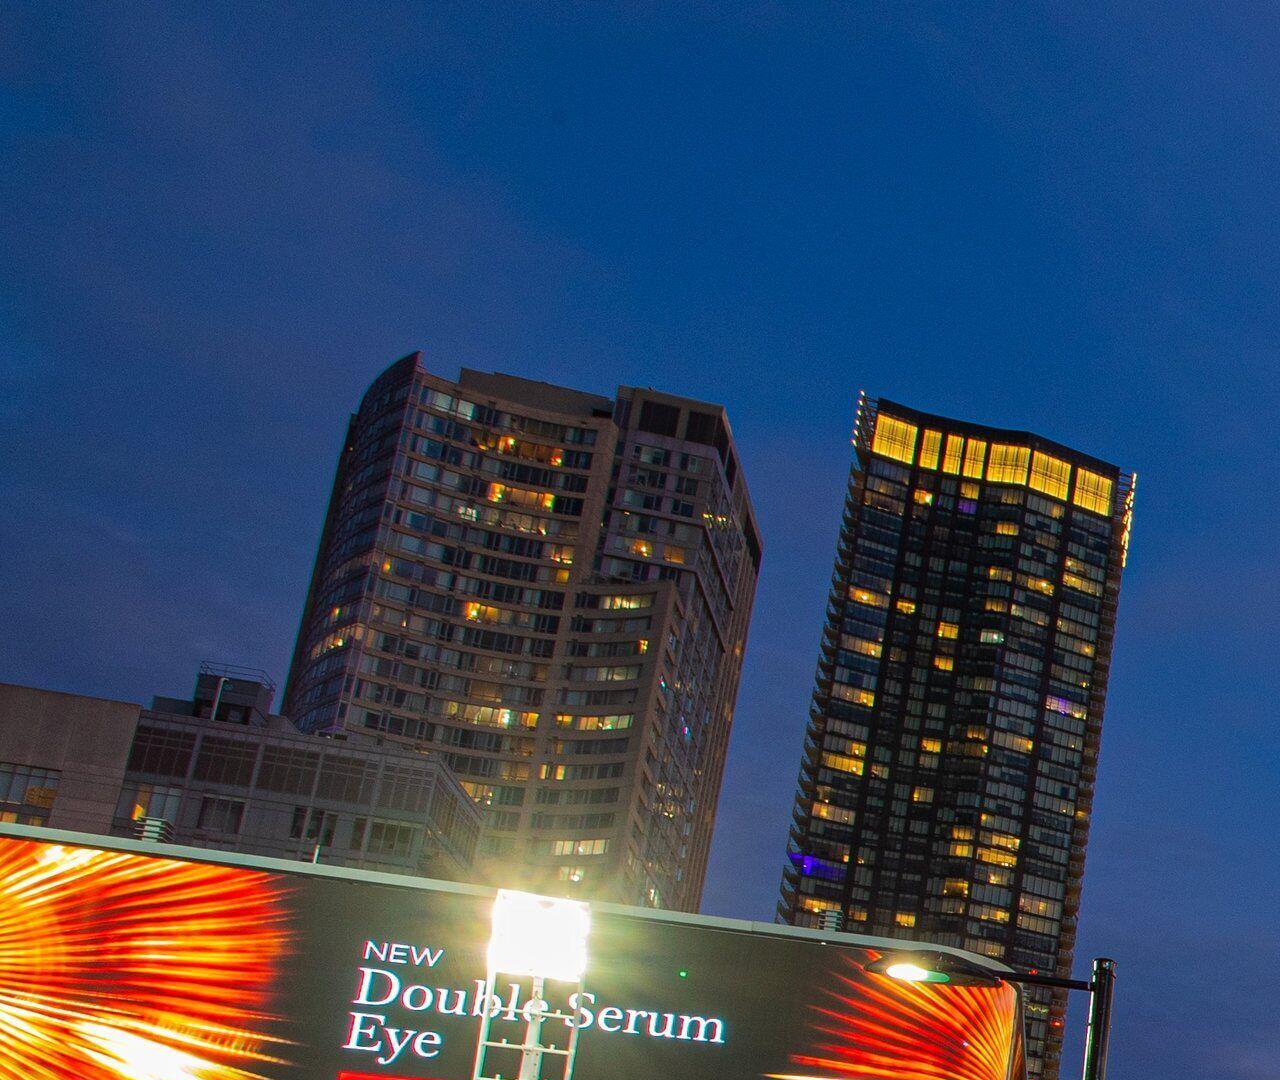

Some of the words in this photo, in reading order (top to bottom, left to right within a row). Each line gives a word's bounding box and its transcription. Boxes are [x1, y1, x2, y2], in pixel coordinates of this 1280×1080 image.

[362, 940, 444, 967] NEW
[352, 966, 548, 1024] Double
[564, 991, 726, 1045] Serum
[342, 1012, 443, 1065] Eye
